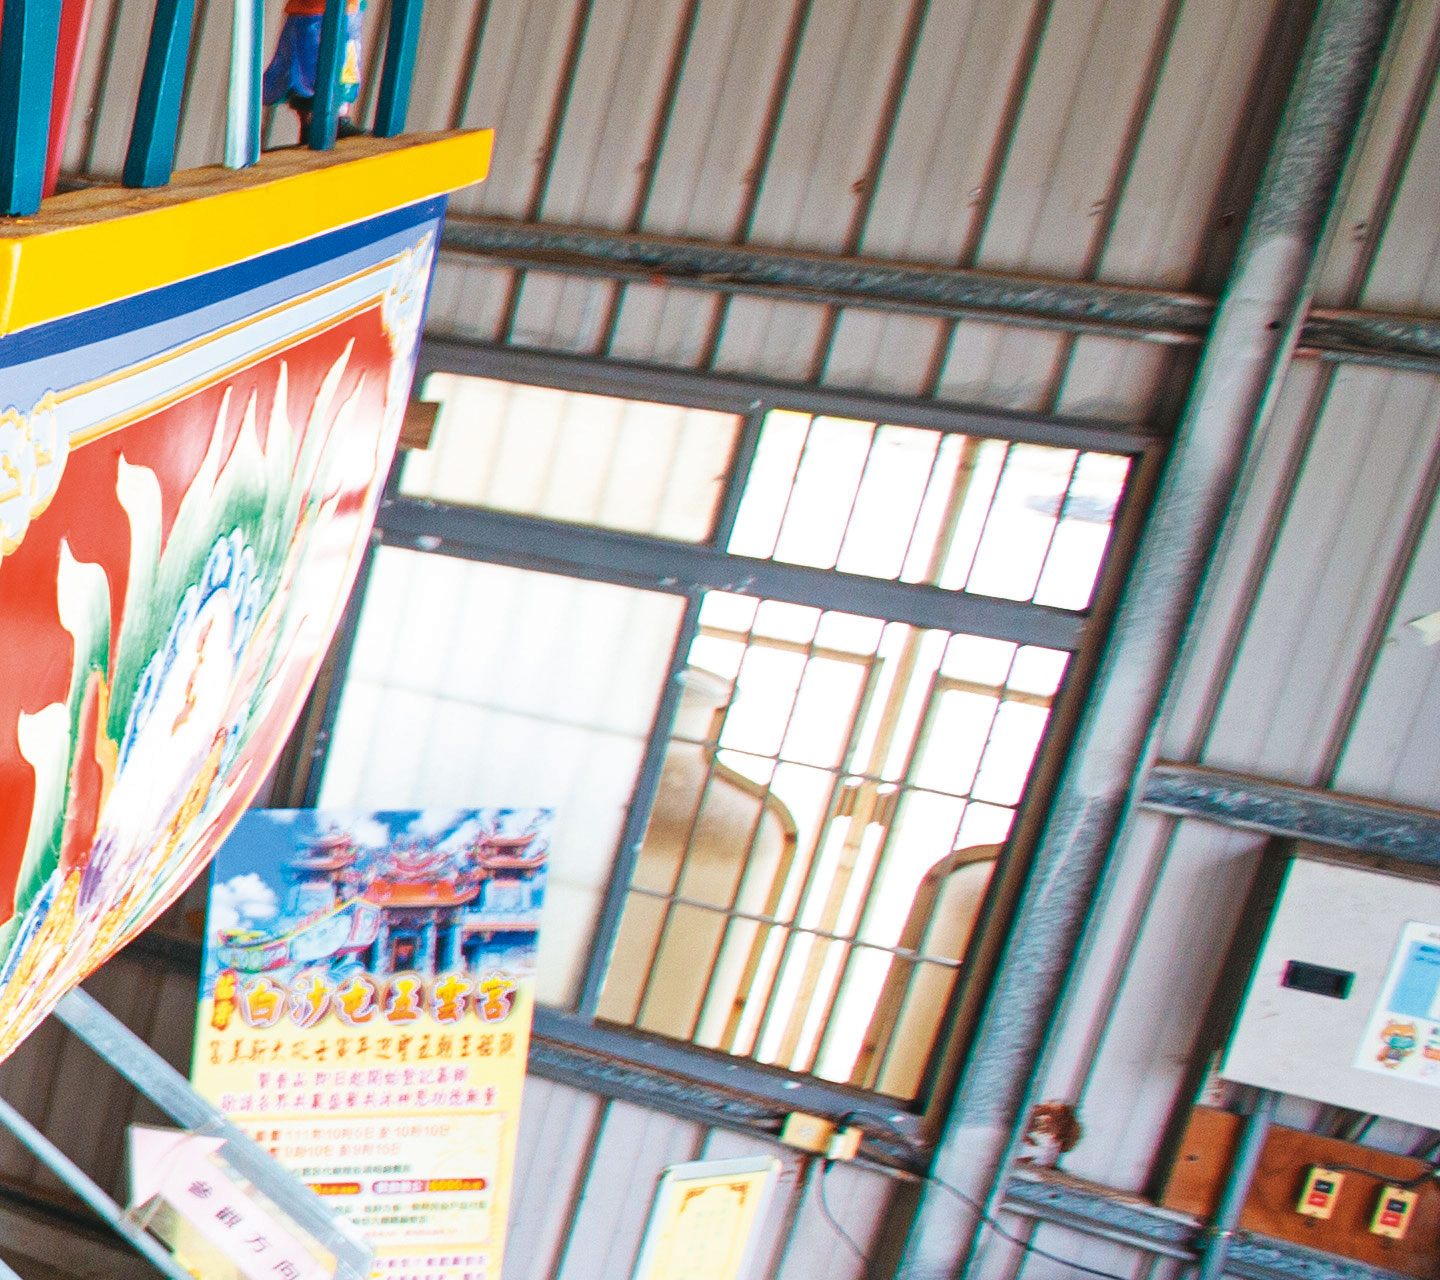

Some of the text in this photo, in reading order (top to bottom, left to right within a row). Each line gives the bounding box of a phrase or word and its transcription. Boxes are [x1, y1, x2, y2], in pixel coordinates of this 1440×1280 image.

[242, 972, 518, 1029] 白沙屯五雲宮
